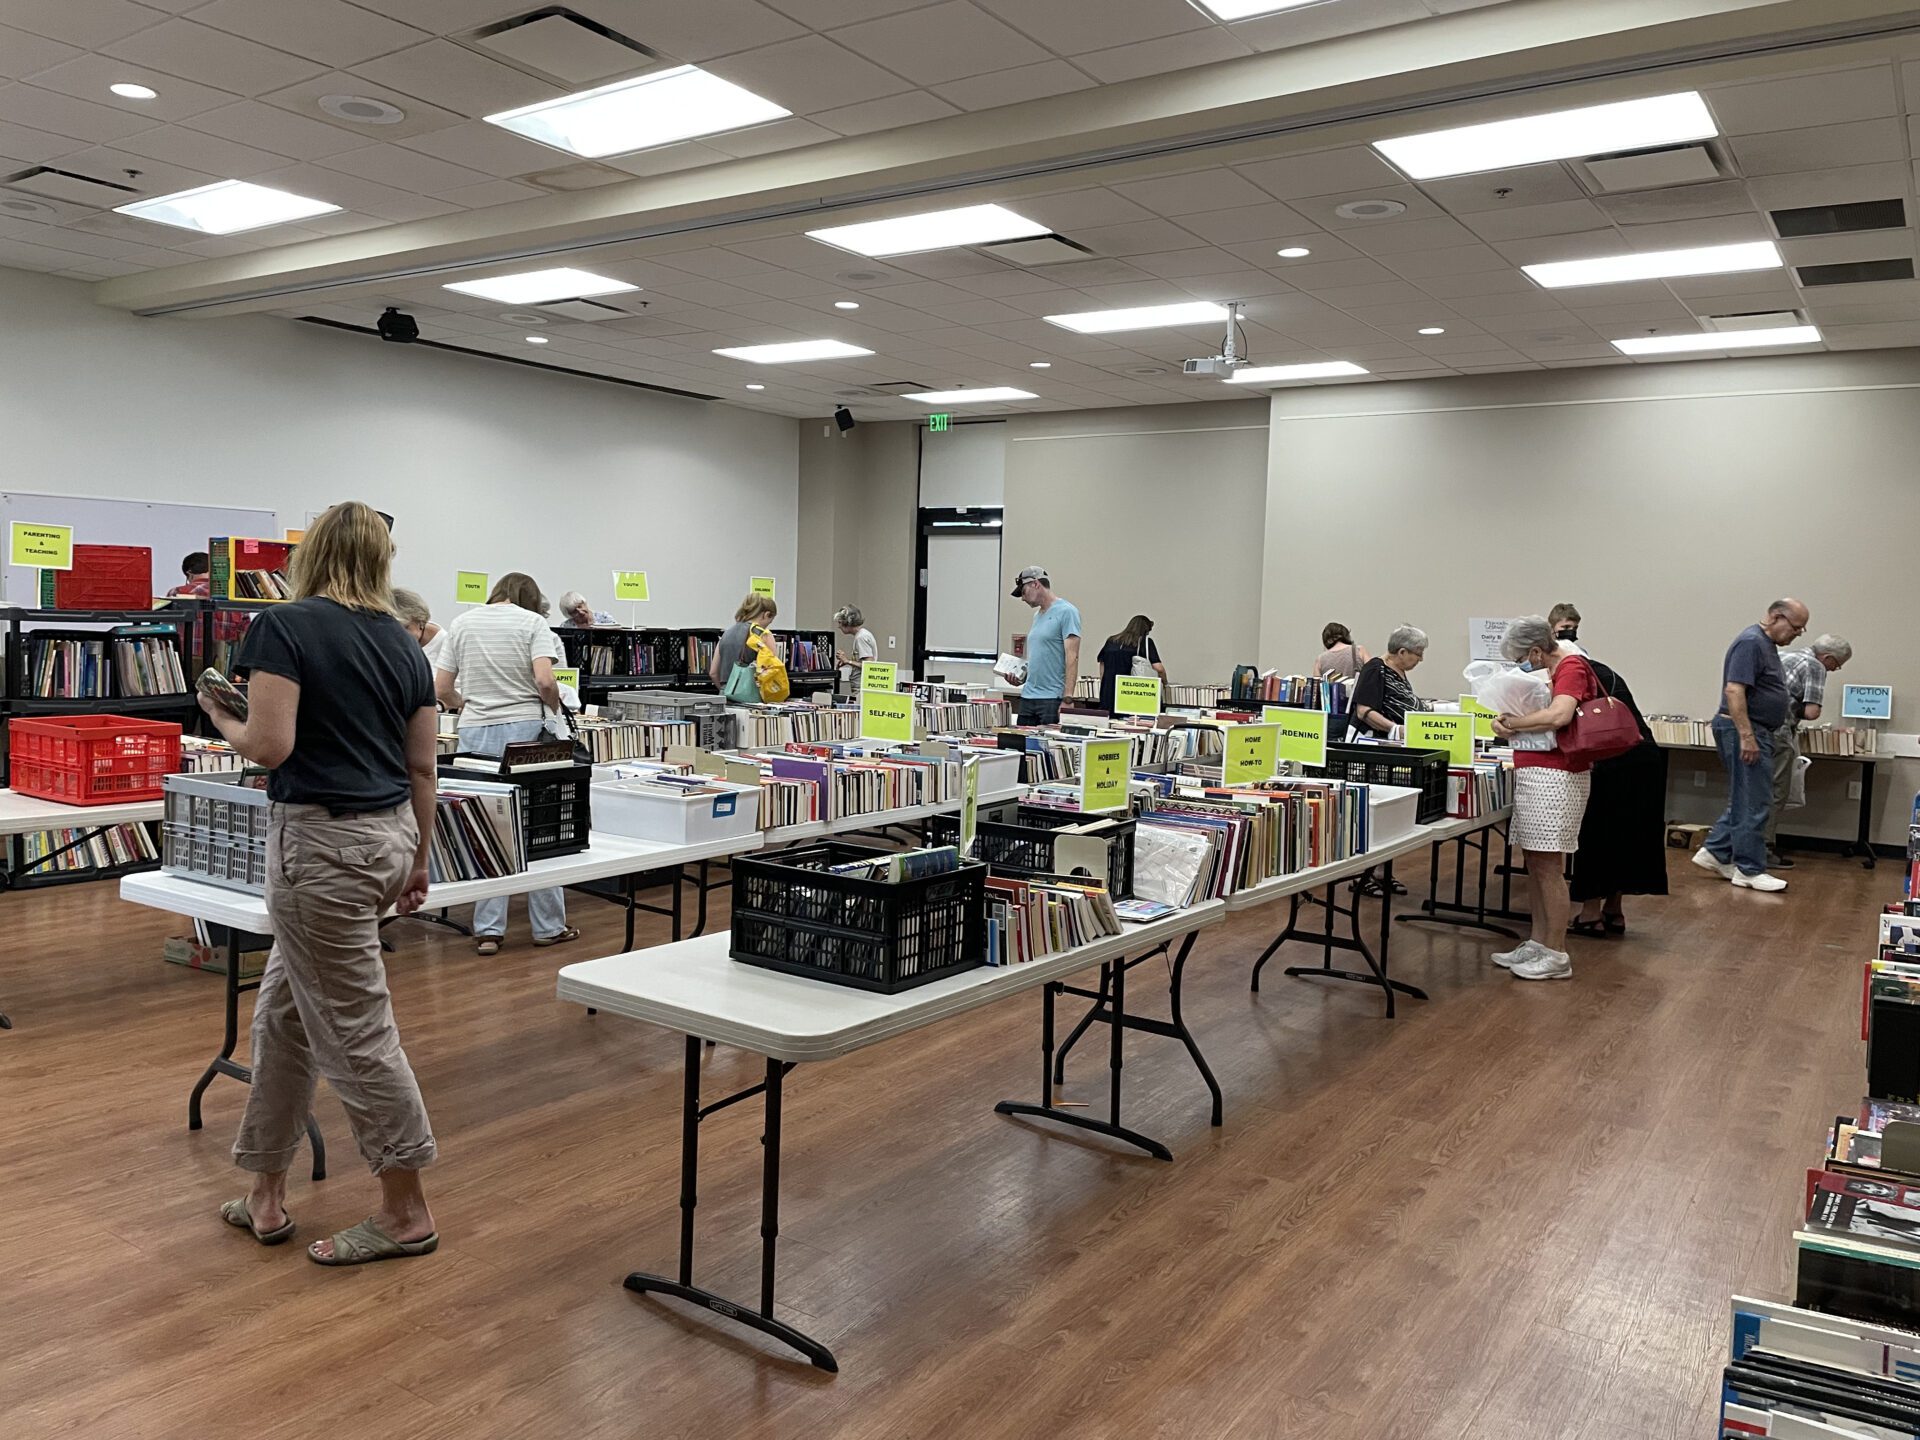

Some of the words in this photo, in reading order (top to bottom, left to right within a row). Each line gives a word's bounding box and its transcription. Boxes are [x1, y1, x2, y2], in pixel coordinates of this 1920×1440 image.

[929, 414, 948, 431] EXIT
[23, 531, 61, 539] PARENTING
[1850, 687, 1889, 696] FICTION
[869, 709, 906, 719] SELF-HELP
[1421, 721, 1457, 729] HEALTH
[1280, 729, 1320, 740] RDENING
[1097, 753, 1120, 761] HOBBIES
[1240, 759, 1263, 767] HOW-TO
[1096, 780, 1118, 789] HOLIDAY
